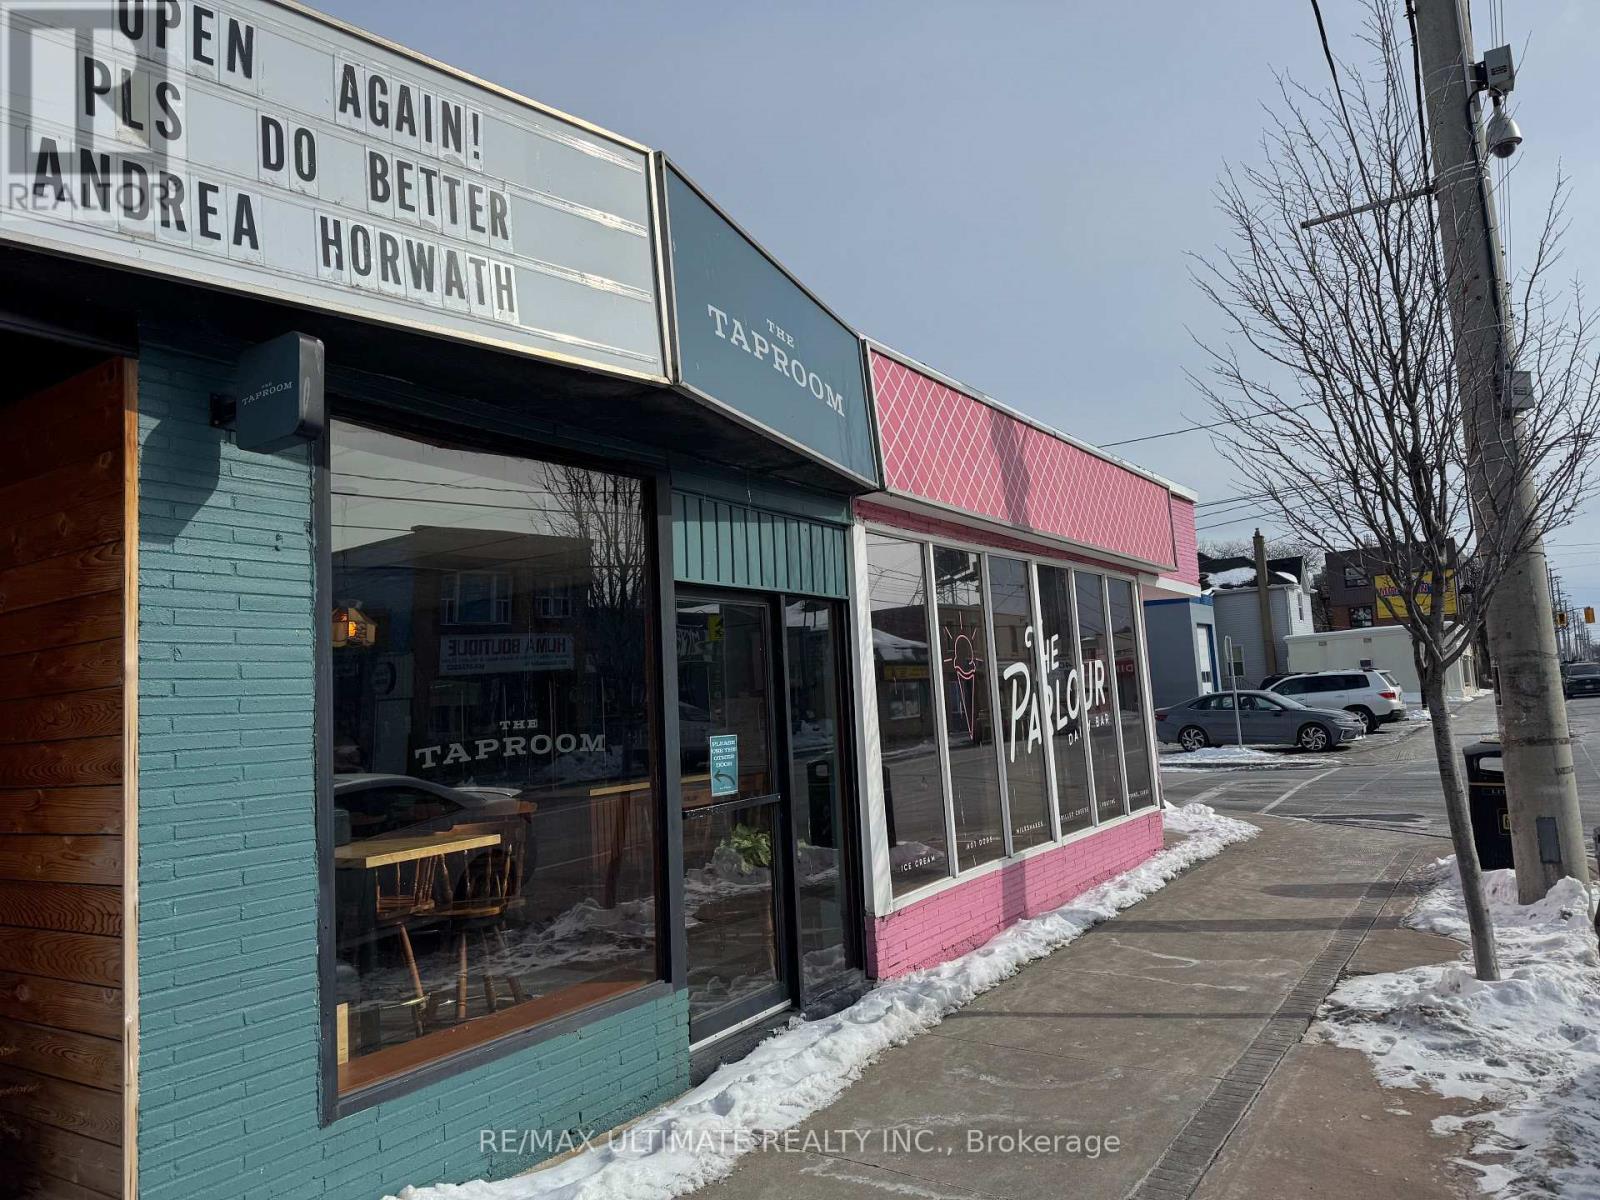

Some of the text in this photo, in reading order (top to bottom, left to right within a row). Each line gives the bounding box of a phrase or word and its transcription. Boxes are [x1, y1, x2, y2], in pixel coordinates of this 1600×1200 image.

[338, 63, 480, 160] AGAIN!
[84, 55, 509, 241] PLS DO BETTER
[33, 136, 515, 313] ANDREA HORWATH
[766, 318, 795, 348] THE
[707, 303, 845, 418] TAPROOM
[241, 381, 294, 406] TAPROOM
[499, 718, 539, 730] THE
[1003, 659, 1106, 763] PARLOUR
[1068, 713, 1110, 746] DAIY BAR
[414, 732, 606, 769] TAPROOM
[900, 854, 937, 873] ICE CREAM
